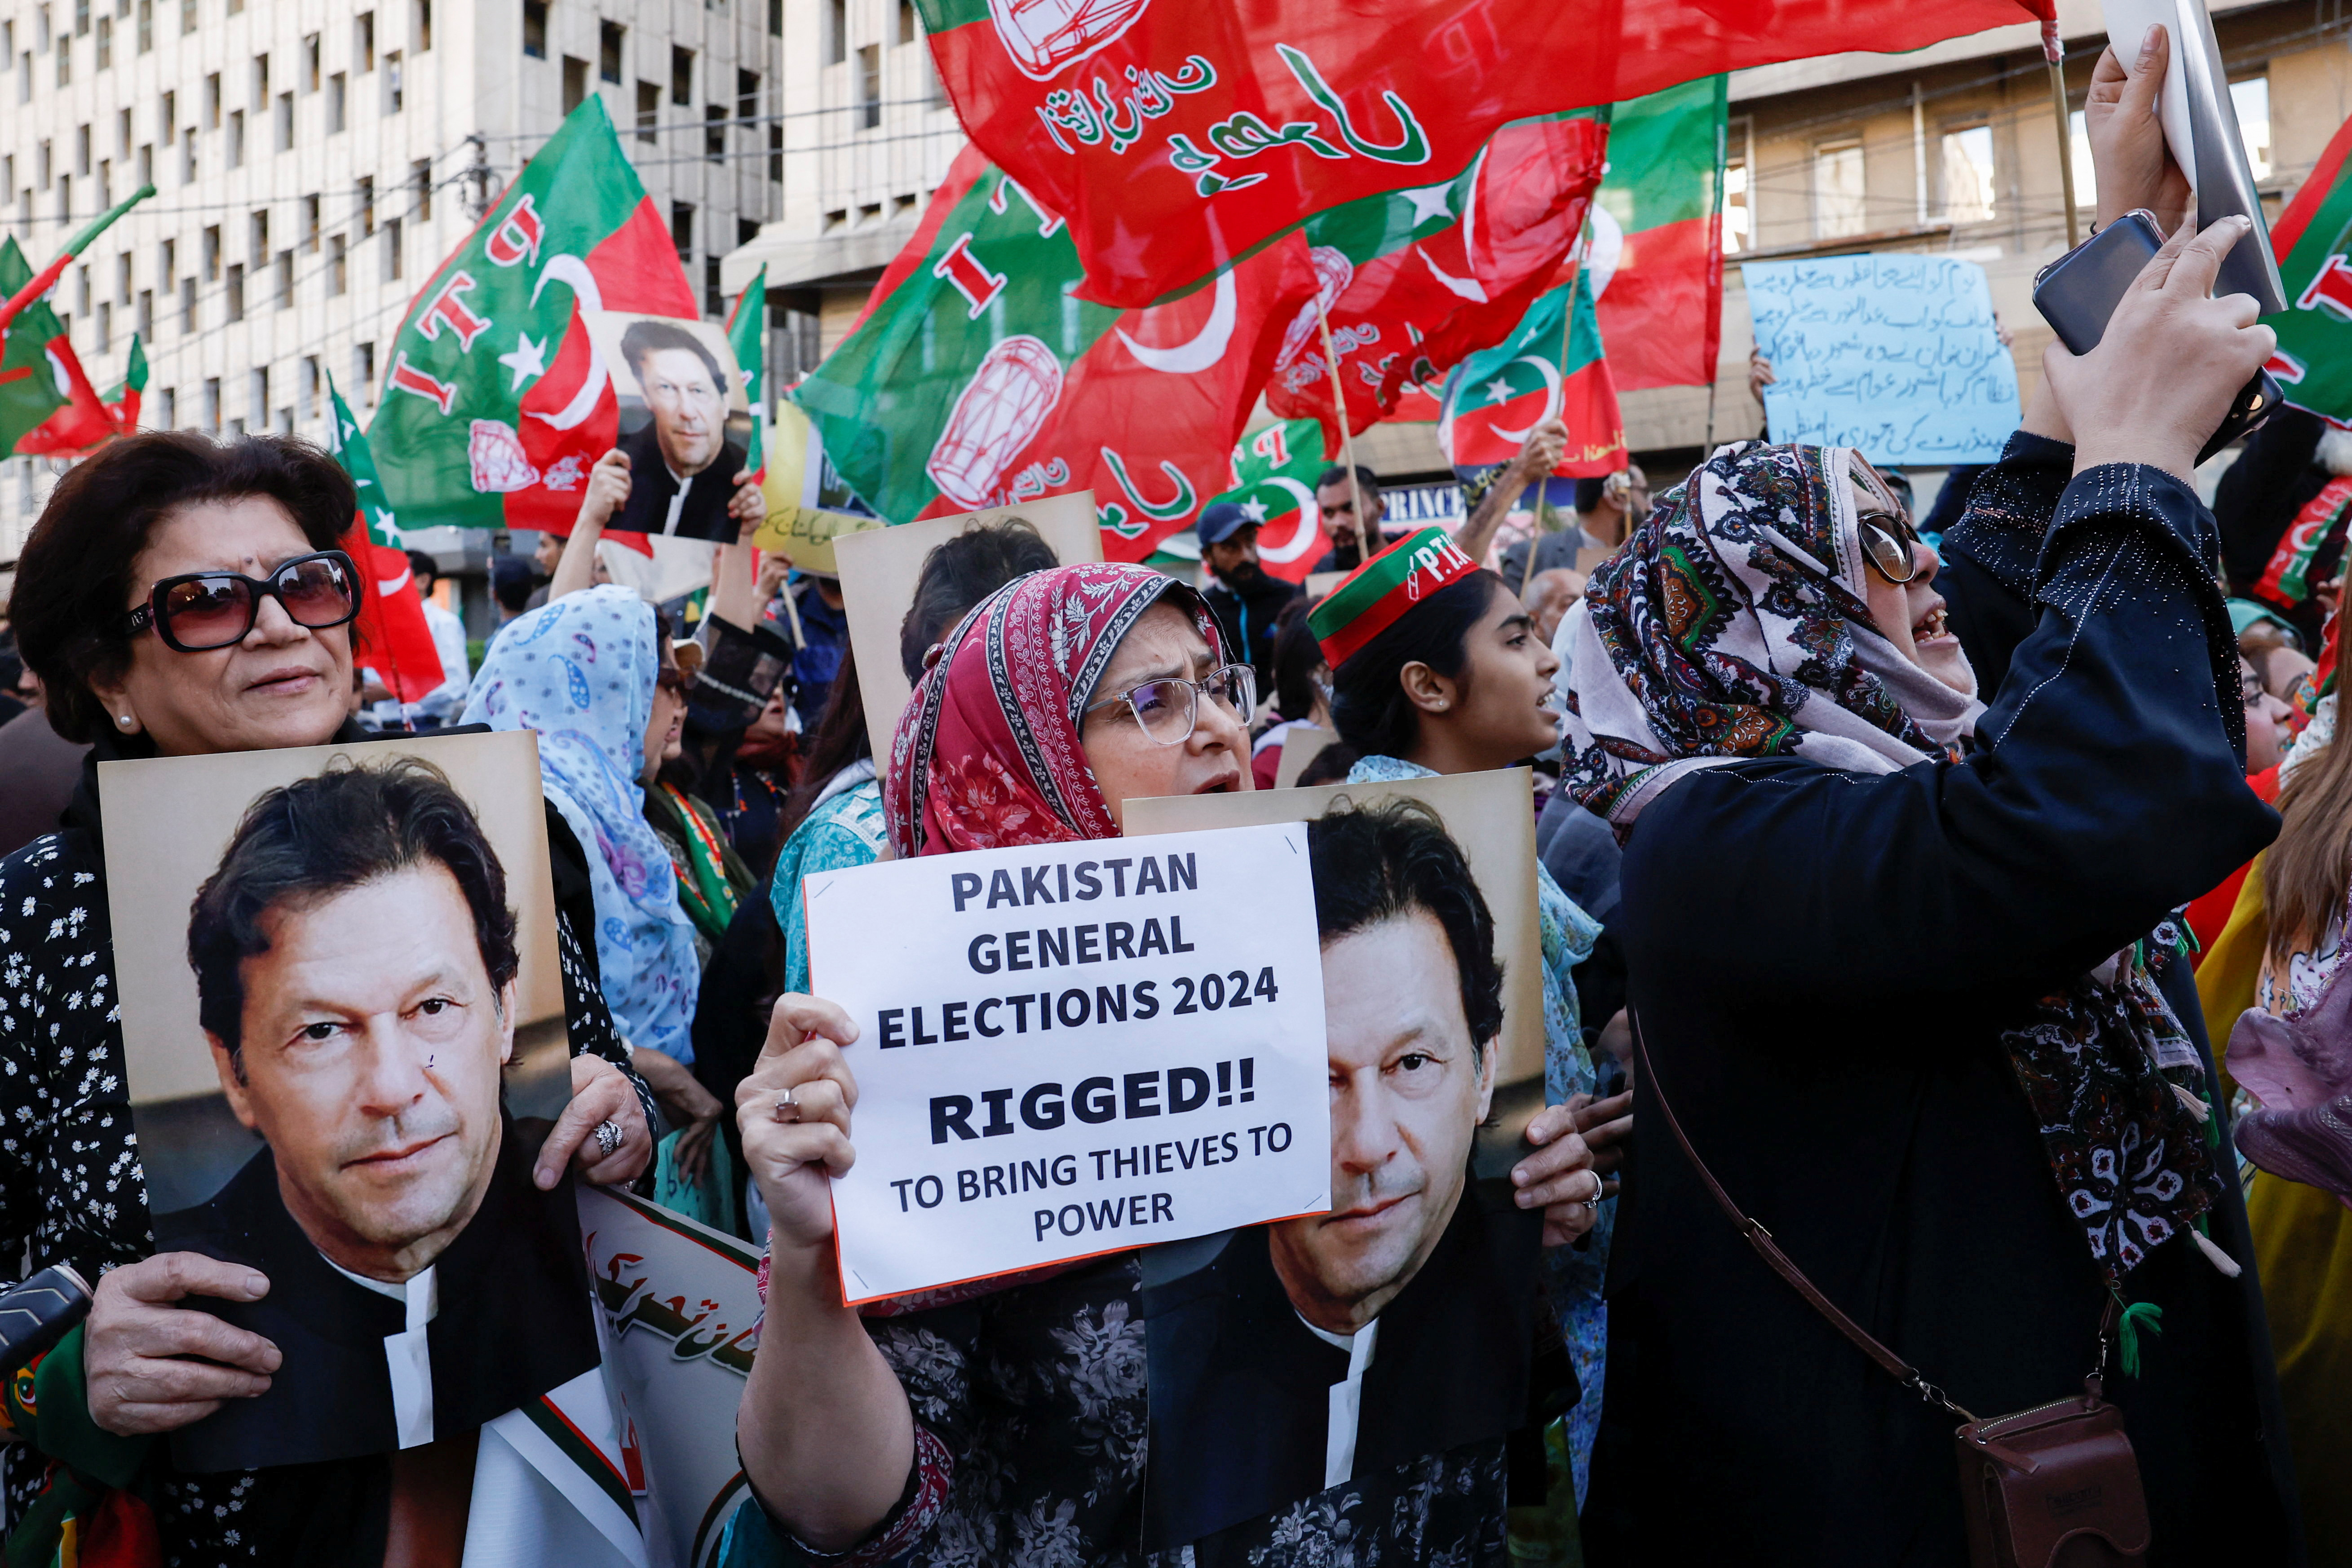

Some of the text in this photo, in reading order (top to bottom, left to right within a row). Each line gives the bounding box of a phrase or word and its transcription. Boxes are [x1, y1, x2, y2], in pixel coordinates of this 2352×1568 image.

[951, 852, 1198, 912] PAKISTAN
[968, 915, 1195, 975] GENERAL
[877, 966, 1279, 1050] ELECTIONS 2024
[929, 1056, 1255, 1145] RIGGED!!
[889, 1122, 1292, 1213] TO BRING THIEVES TO
[1034, 1192, 1175, 1242] POWER
